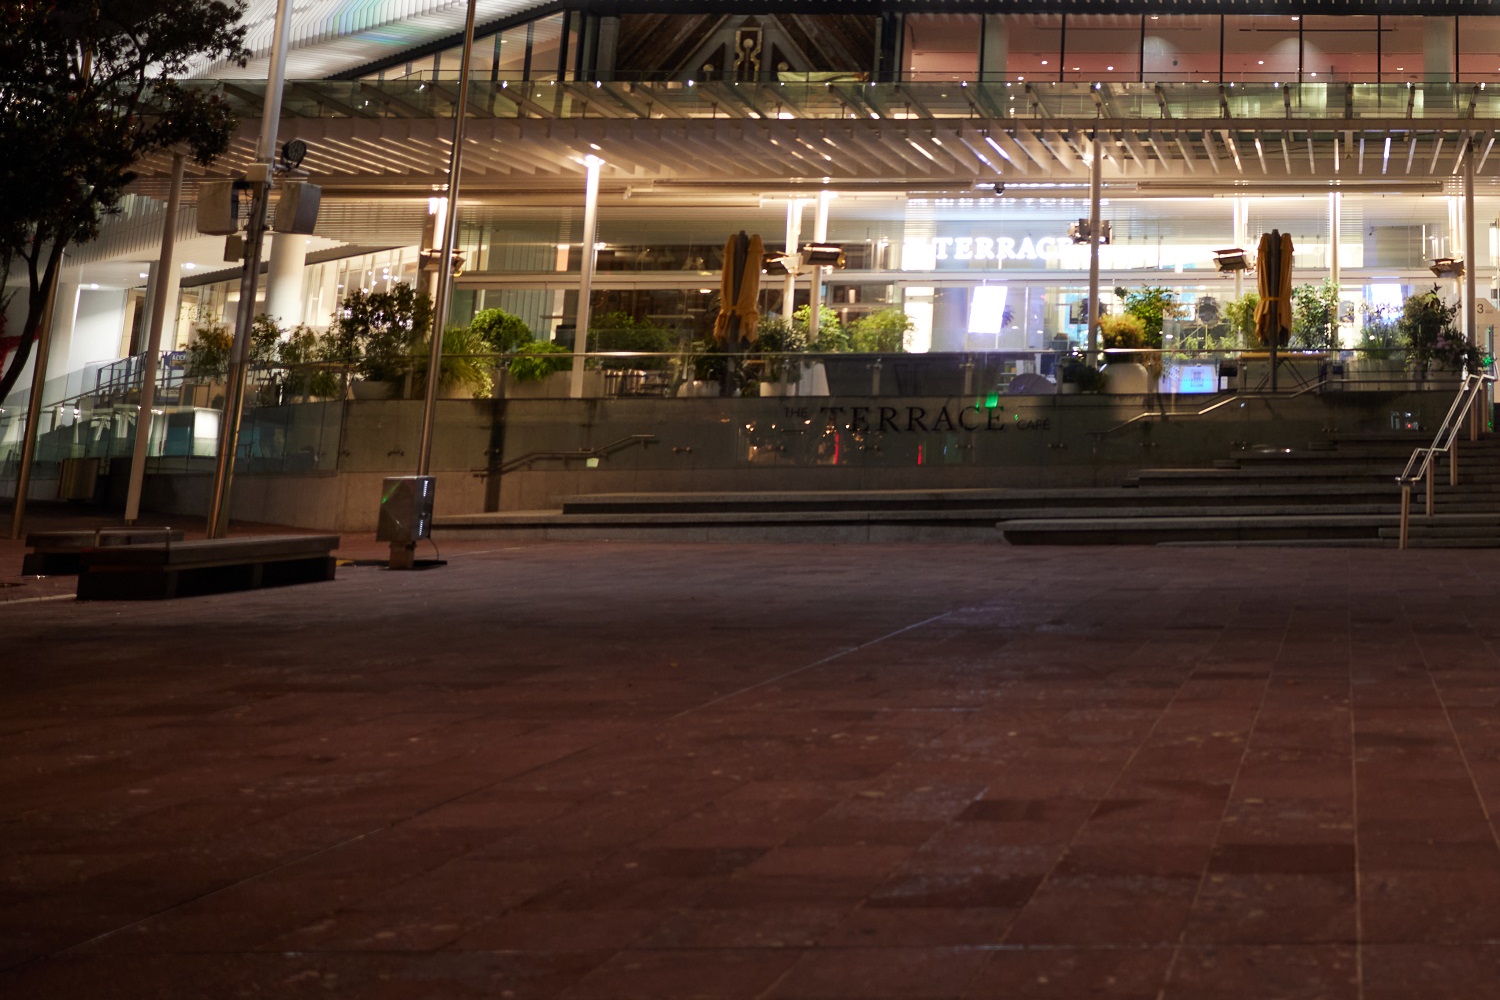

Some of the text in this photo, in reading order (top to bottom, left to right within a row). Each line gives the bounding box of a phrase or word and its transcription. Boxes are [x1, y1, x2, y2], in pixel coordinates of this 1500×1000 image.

[1476, 303, 1484, 314] 3
[784, 406, 1051, 432] THE TERRACE CAFÉ
